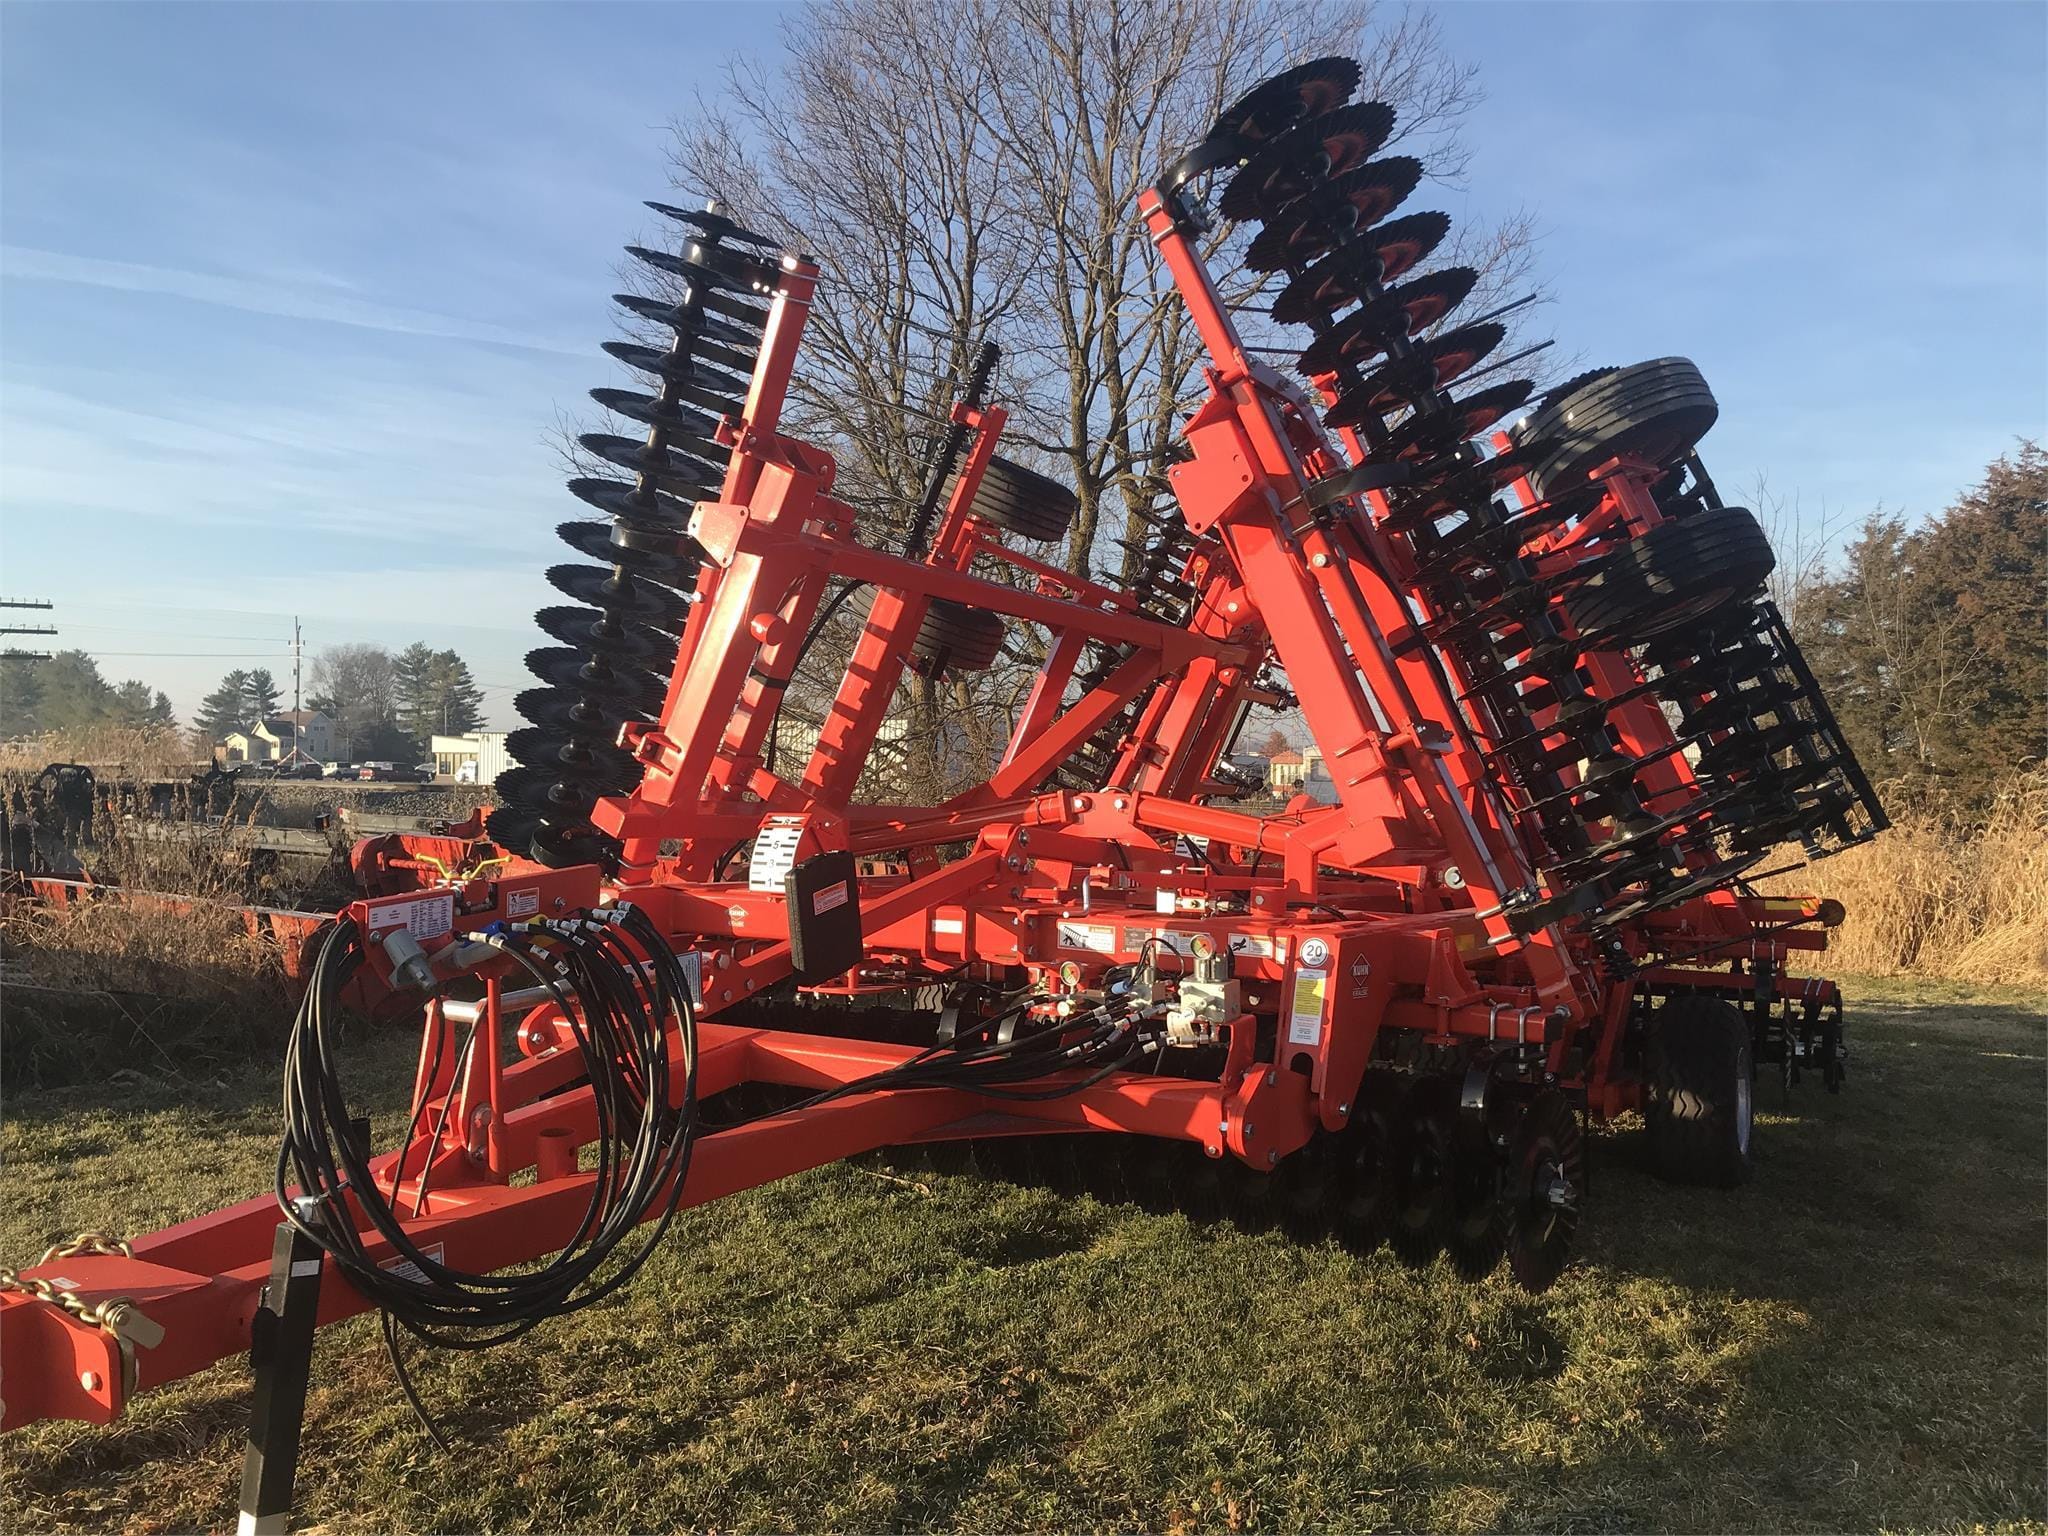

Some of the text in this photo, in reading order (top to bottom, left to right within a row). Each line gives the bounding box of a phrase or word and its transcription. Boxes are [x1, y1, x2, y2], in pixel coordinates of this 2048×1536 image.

[773, 840, 780, 850] 5
[769, 859, 775, 868] 3
[1306, 945, 1323, 958] 20
[1353, 964, 1369, 976] KUHN
